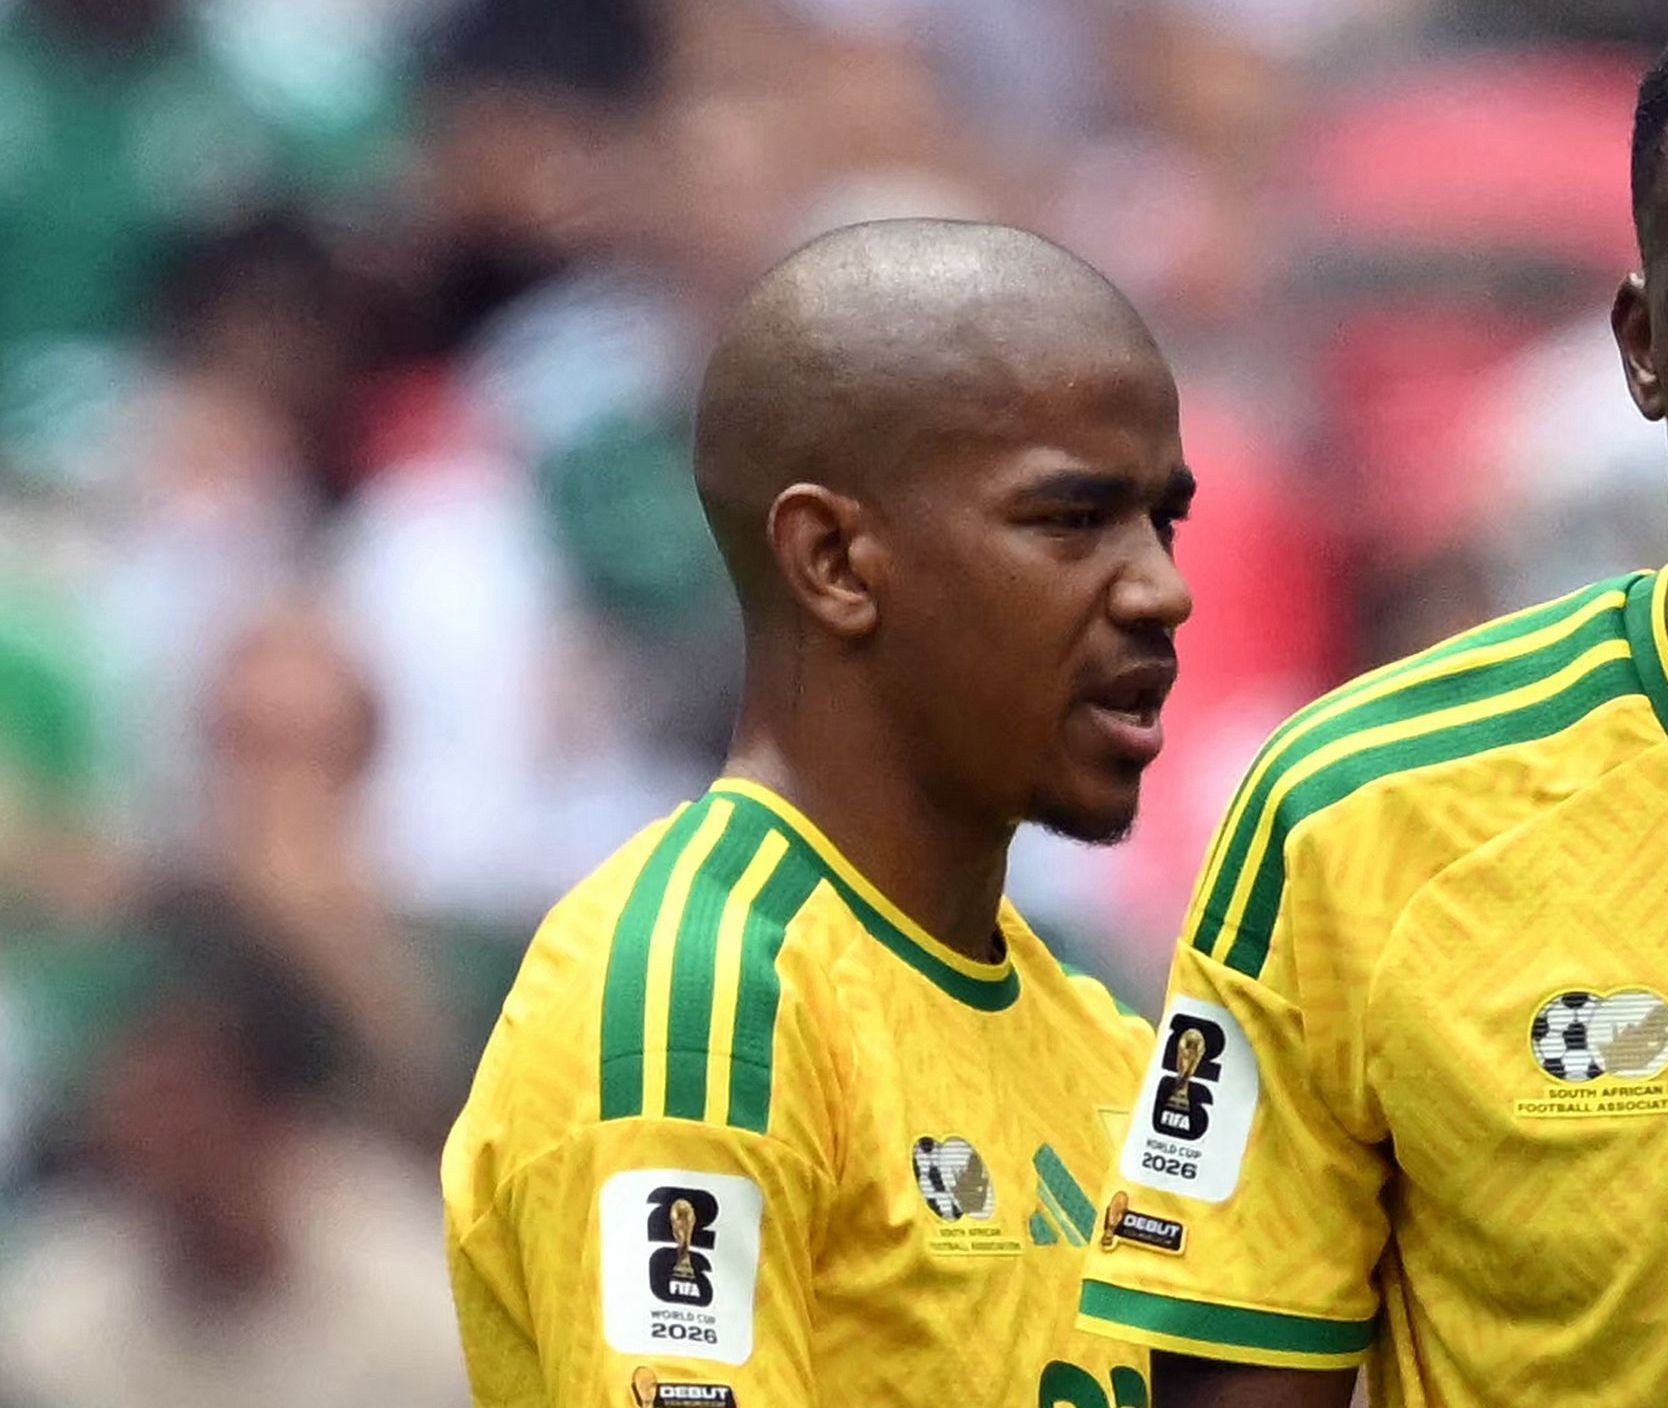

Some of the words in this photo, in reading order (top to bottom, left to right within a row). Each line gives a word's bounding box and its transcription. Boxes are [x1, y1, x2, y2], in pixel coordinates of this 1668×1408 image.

[1549, 1088, 1597, 1099] SOUTH
[1602, 1085, 1664, 1097] AFRICAN
[1518, 1102, 1592, 1113] FOOTBALL
[1161, 1110, 1190, 1131] FIFA
[1142, 1152, 1198, 1180] 2026
[669, 1281, 701, 1298] FIFA
[651, 1322, 718, 1345] 2026
[660, 1386, 729, 1400] DEBUT
